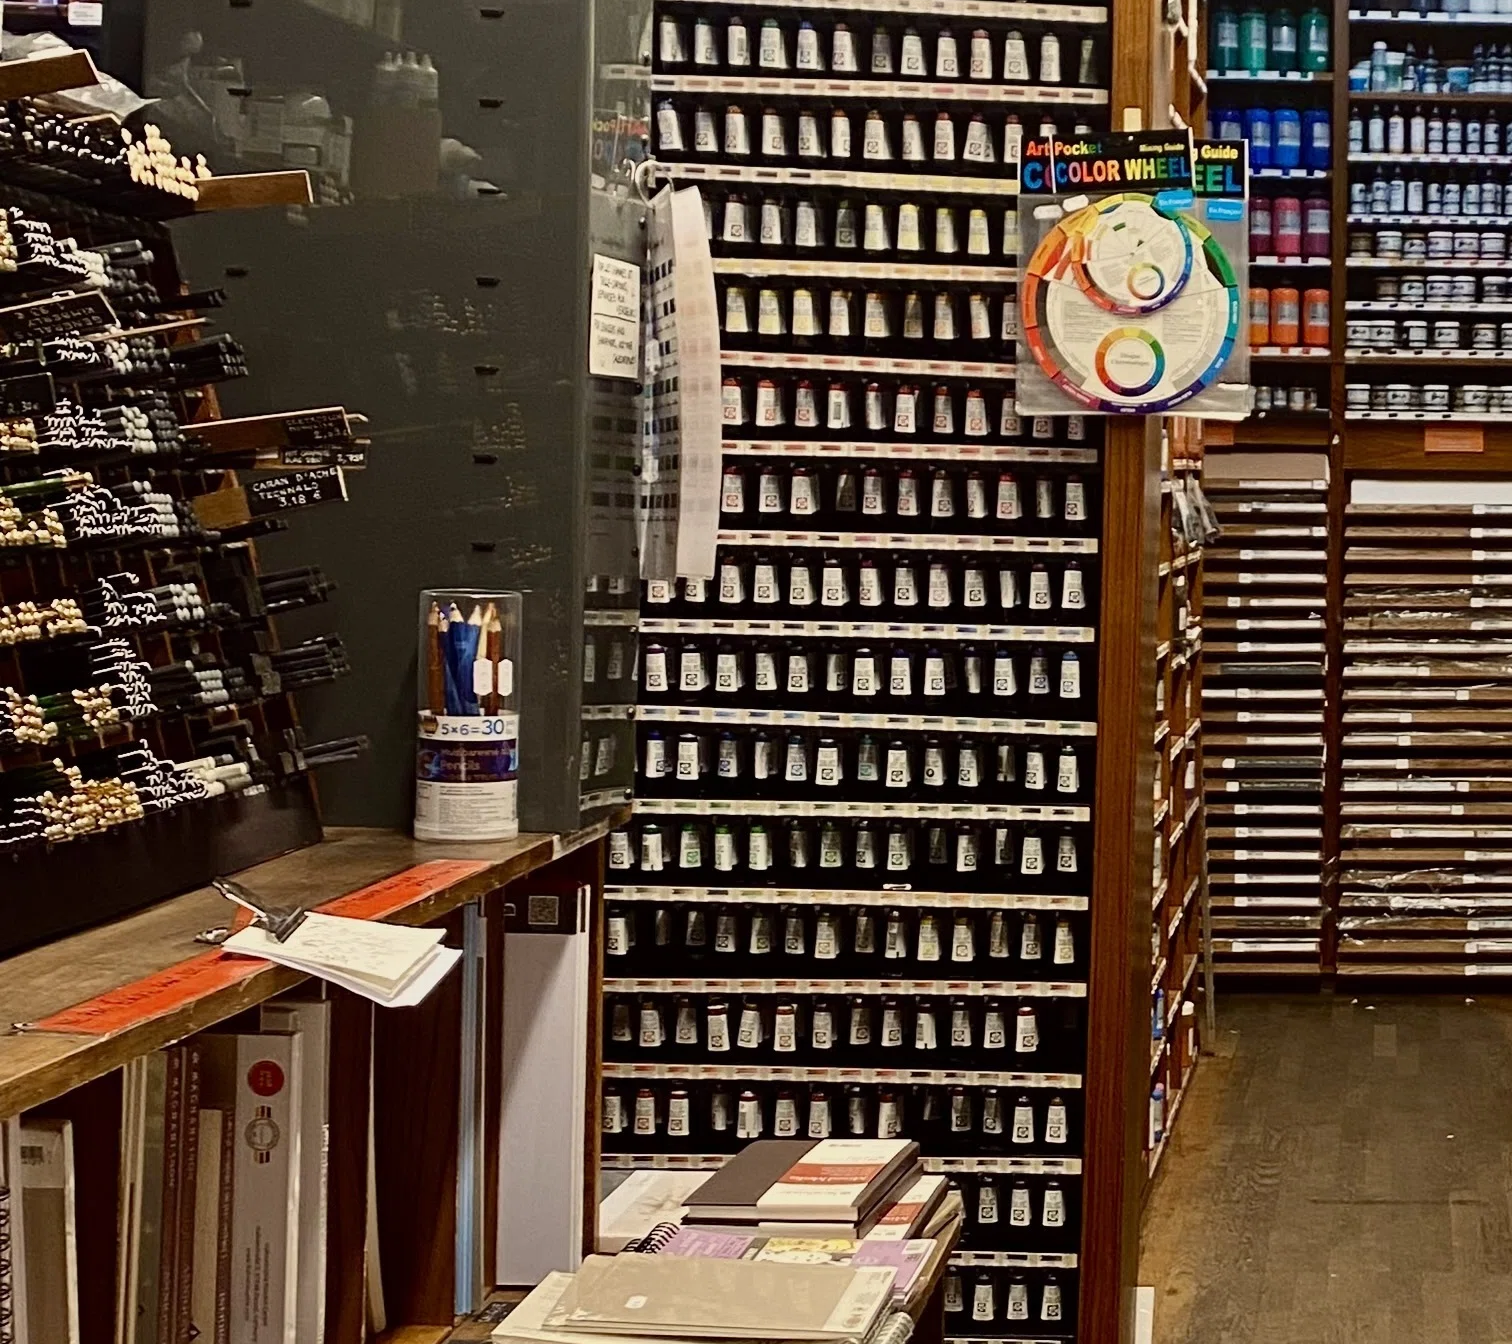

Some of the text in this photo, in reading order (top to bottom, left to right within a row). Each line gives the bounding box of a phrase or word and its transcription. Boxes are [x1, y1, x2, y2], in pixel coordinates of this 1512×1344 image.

[1054, 141, 1101, 157] Pocket
[1200, 144, 1240, 160] Guide
[1055, 161, 1121, 185] COLOR
[1123, 156, 1191, 181] WHEEL
[28, 307, 96, 327] KIMBERLY
[252, 466, 338, 492] CARAN D'ACHE
